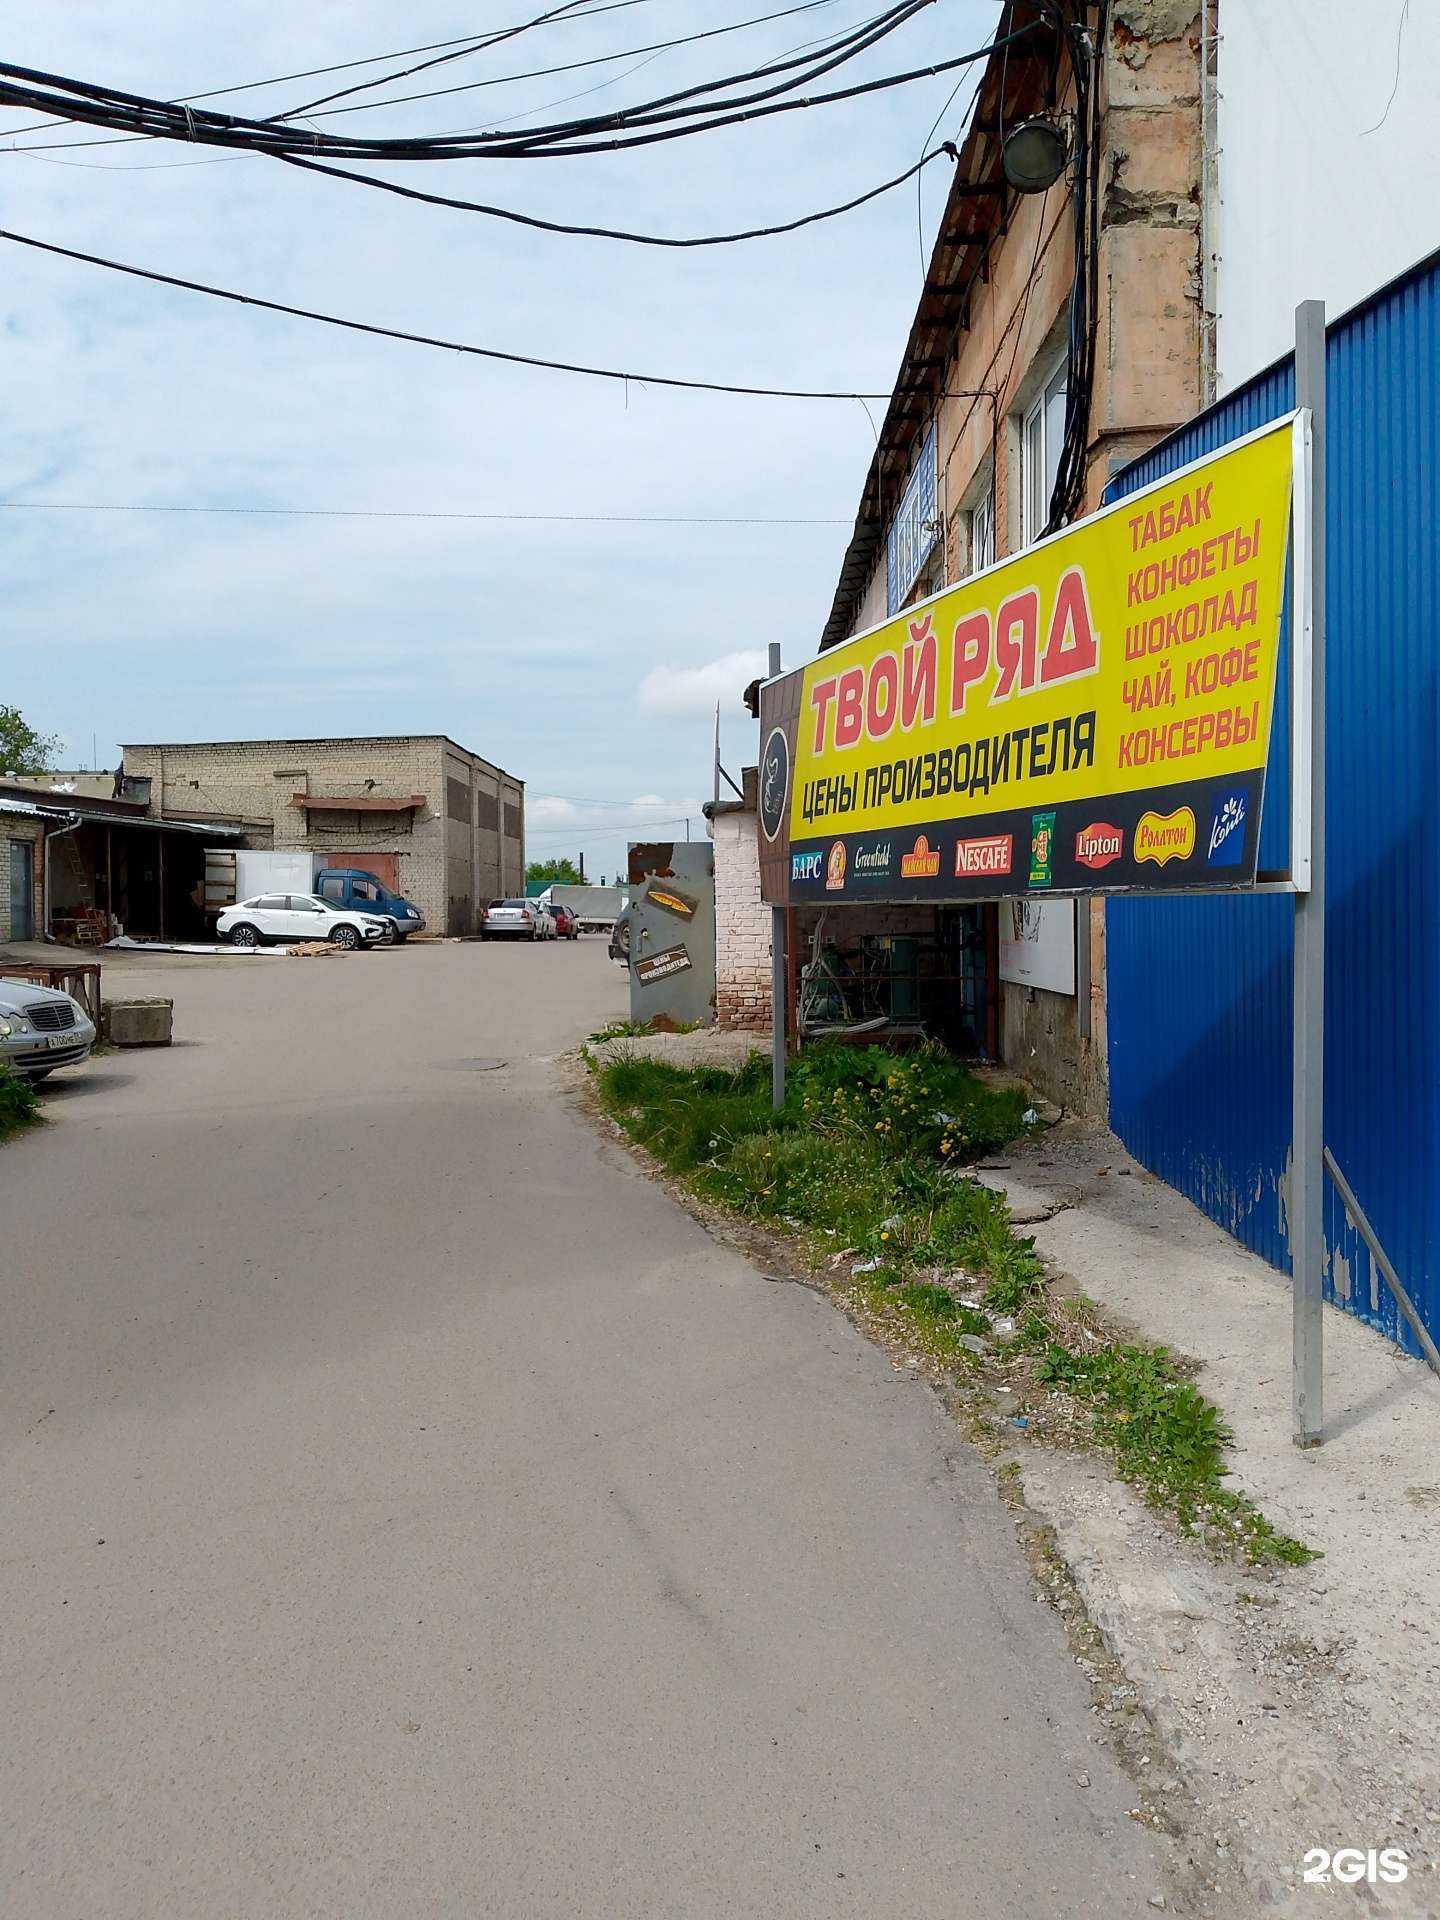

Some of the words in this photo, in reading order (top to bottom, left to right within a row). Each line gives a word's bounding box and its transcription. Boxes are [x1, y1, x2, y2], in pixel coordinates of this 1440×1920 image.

[1128, 481, 1214, 552] ТАБАК
[1127, 518, 1261, 608] КОНФЕТЫ
[1125, 579, 1258, 662] ШОКОЛАД
[811, 612, 938, 755] ТВОЙ
[950, 568, 1098, 714] РЯД
[1122, 659, 1176, 713] ЧАЙ,
[1184, 639, 1261, 699] КОФЕ
[801, 772, 858, 824] ЦЕНЫ
[862, 710, 1097, 810] ПРОИЗВОДИТЕЛЯ
[1118, 700, 1260, 769] КОНСЕРВЫ
[792, 853, 823, 881] БАРС
[855, 842, 891, 868] Greenfield
[956, 838, 1009, 872] NESCAFÉ
[1078, 835, 1119, 861] Lipton
